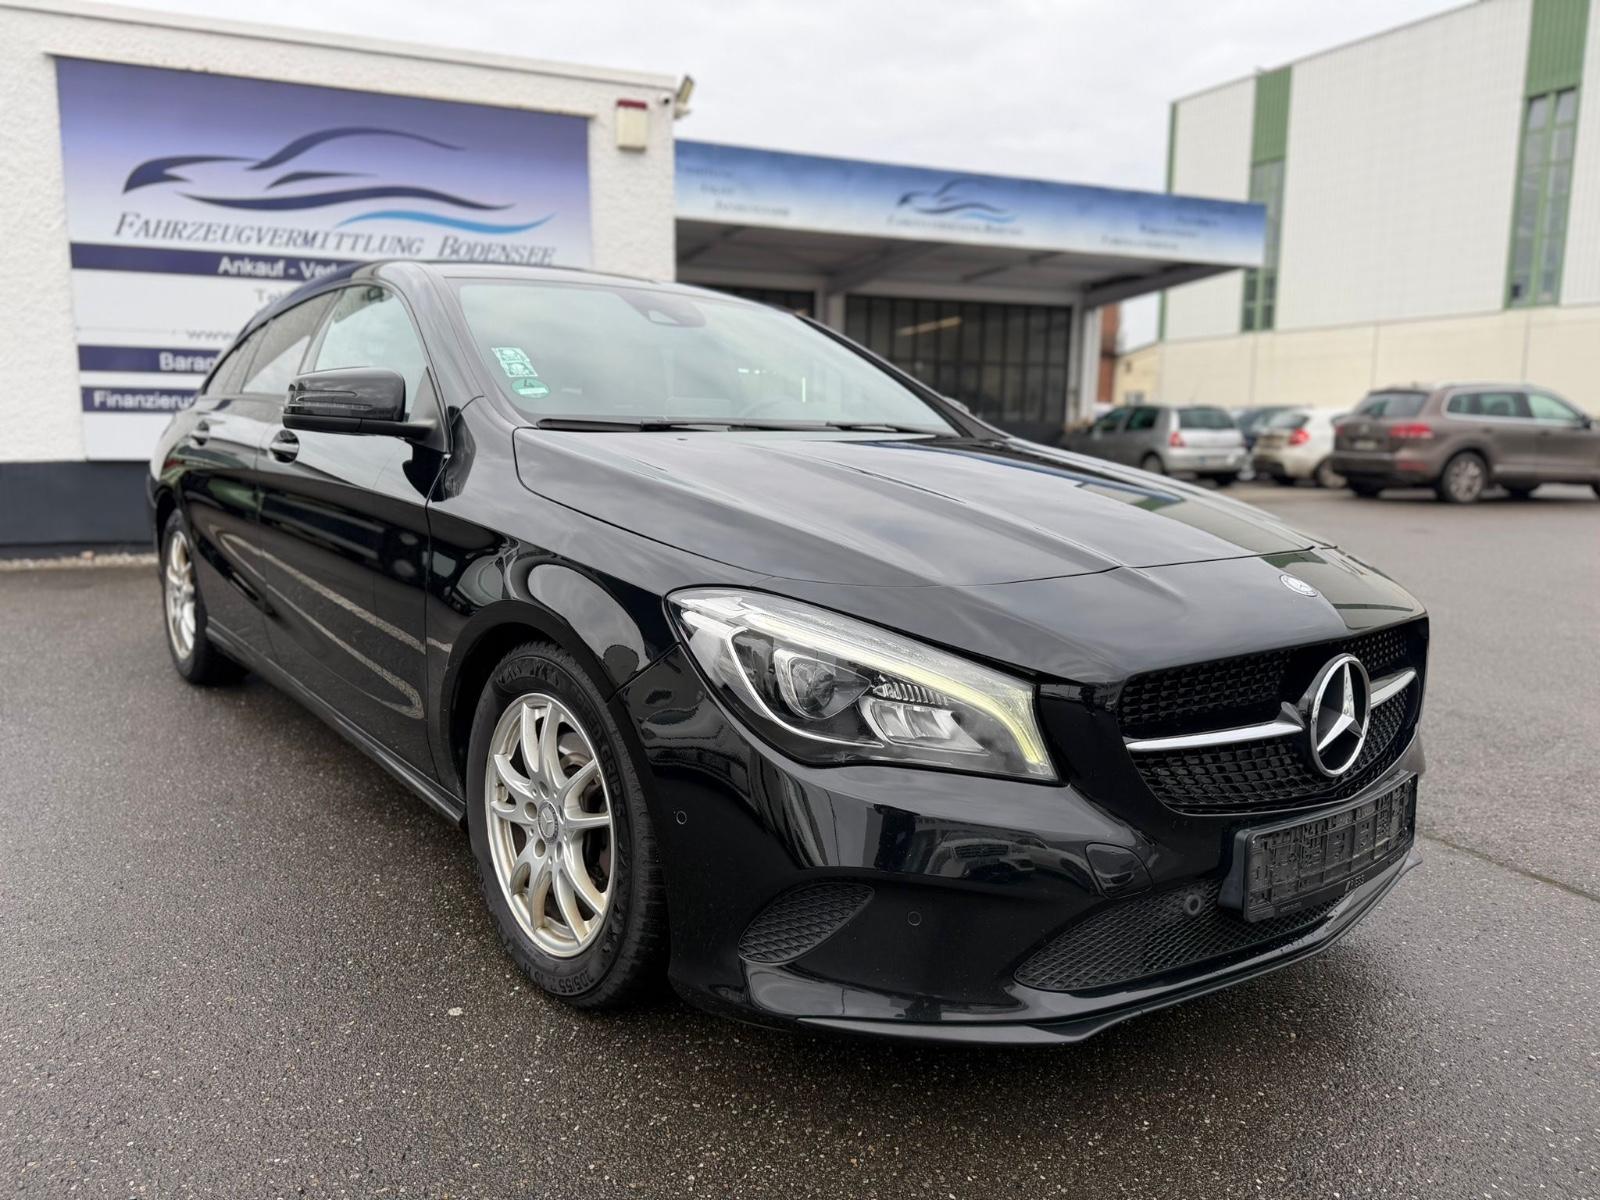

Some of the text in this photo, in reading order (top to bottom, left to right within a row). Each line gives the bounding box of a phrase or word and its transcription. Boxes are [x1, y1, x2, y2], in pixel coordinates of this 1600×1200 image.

[114, 211, 557, 264] FAHRZEUGVERMITTLUNG BODENSEE
[217, 255, 285, 278] Ankauf
